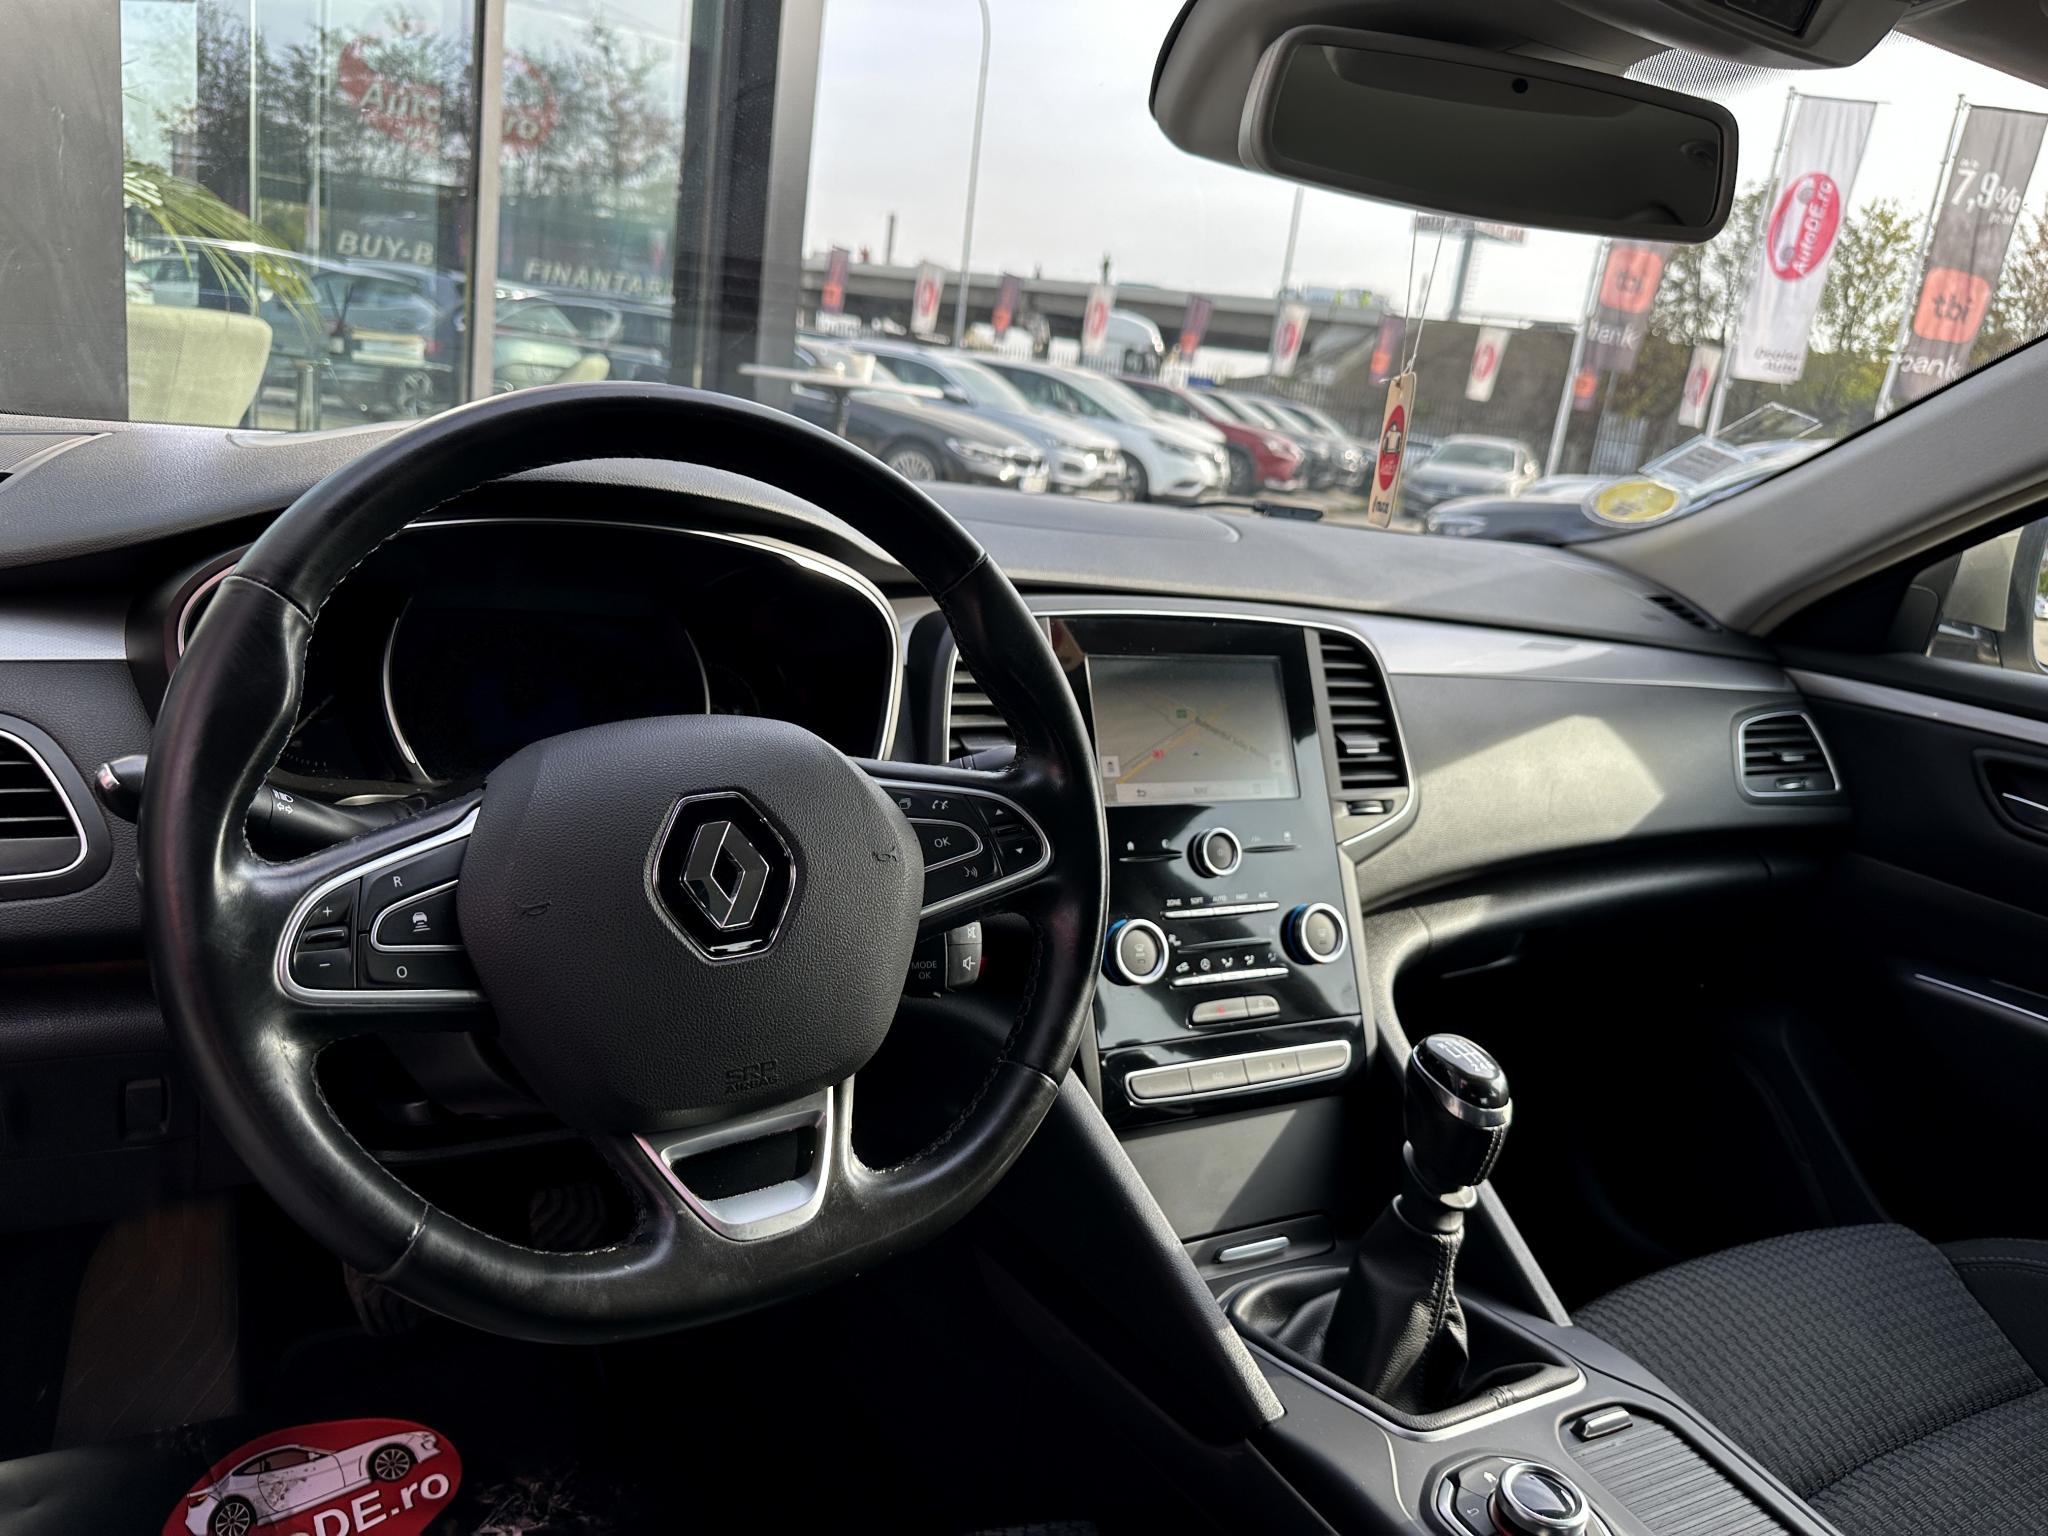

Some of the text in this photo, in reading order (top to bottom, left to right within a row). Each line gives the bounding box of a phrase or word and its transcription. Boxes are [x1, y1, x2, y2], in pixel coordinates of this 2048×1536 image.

[1951, 168, 2021, 214] 7,9%
[1932, 294, 1970, 325] tbi
[934, 837, 951, 848] OK
[393, 876, 403, 888] R
[911, 961, 937, 970] MODE
[918, 972, 931, 980] OK
[292, 1473, 449, 1536] DE.ro
